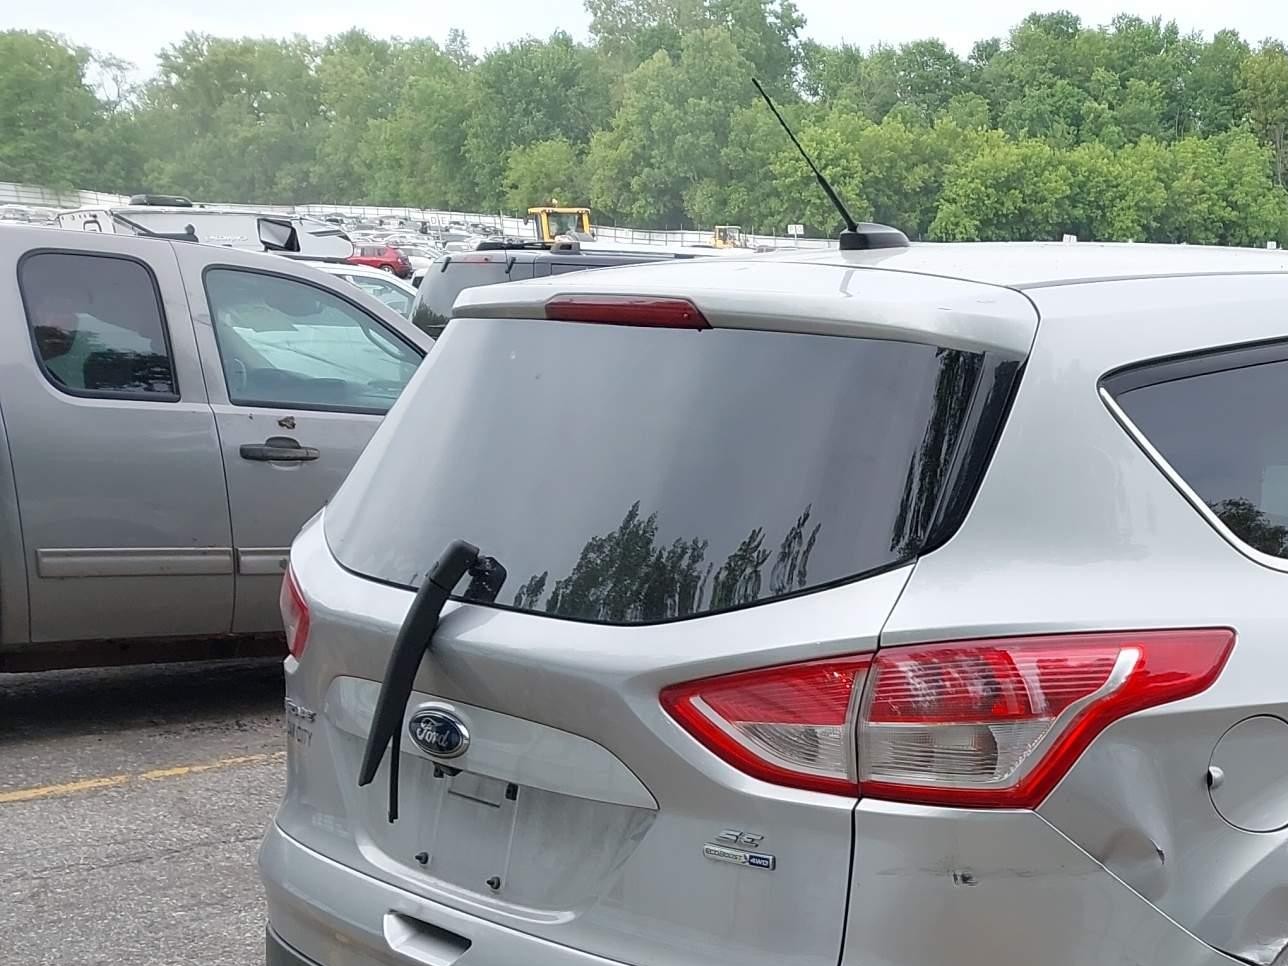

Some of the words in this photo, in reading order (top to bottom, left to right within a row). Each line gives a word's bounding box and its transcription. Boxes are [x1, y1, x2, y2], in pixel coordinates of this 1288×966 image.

[416, 717, 450, 748] Ford
[718, 829, 764, 847] SE
[750, 857, 769, 866] 4WD
